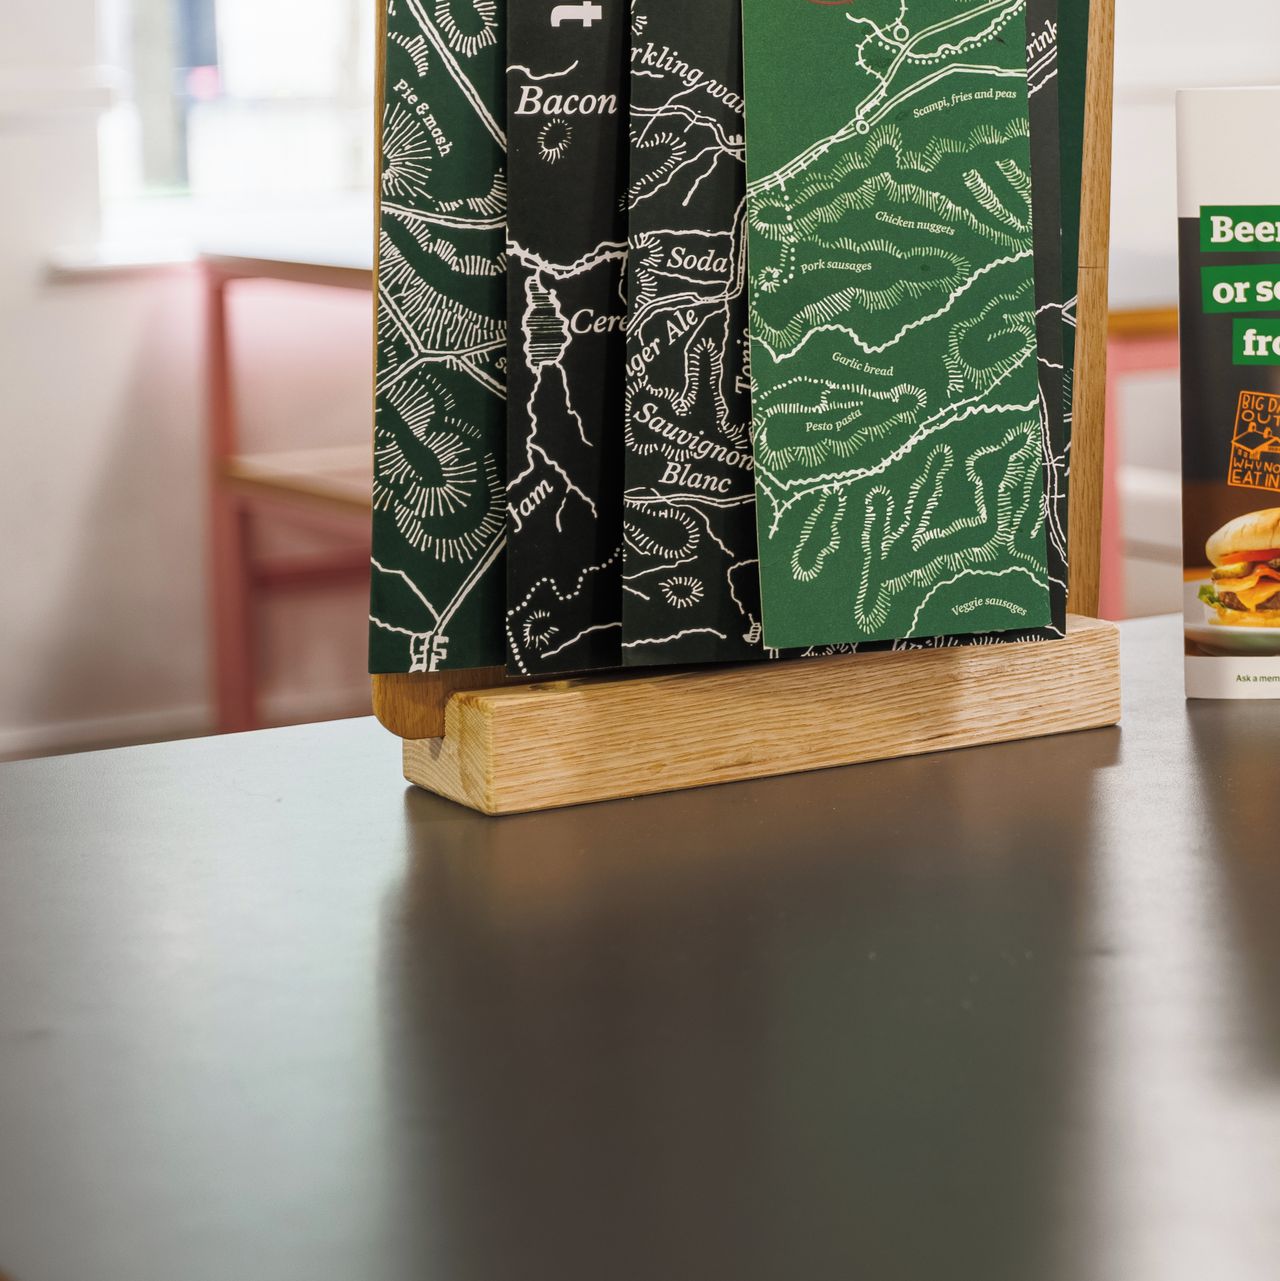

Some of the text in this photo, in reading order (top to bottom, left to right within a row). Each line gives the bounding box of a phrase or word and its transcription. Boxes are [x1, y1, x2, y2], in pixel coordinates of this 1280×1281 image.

[1026, 19, 1057, 62] rink
[514, 85, 618, 115] Bacon
[913, 88, 1017, 118] Scampi, fries and peas
[393, 79, 453, 157] Pie & mash
[875, 211, 955, 236] Chicken nuggets
[666, 246, 728, 273] Soda
[827, 260, 872, 273] sausages
[1212, 280, 1250, 304] or
[664, 309, 699, 345] Ale
[832, 352, 894, 376] Garlic bread
[1242, 394, 1264, 411] BIG
[806, 409, 862, 432] Pesto pasta
[632, 403, 754, 470] Sauvignon
[1233, 457, 1262, 470] WHY
[658, 461, 732, 493] Blanc
[1232, 469, 1262, 485] EAT
[506, 480, 554, 533] Jam
[951, 597, 1028, 616] Veggie sausages
[1236, 674, 1251, 682] Ask
